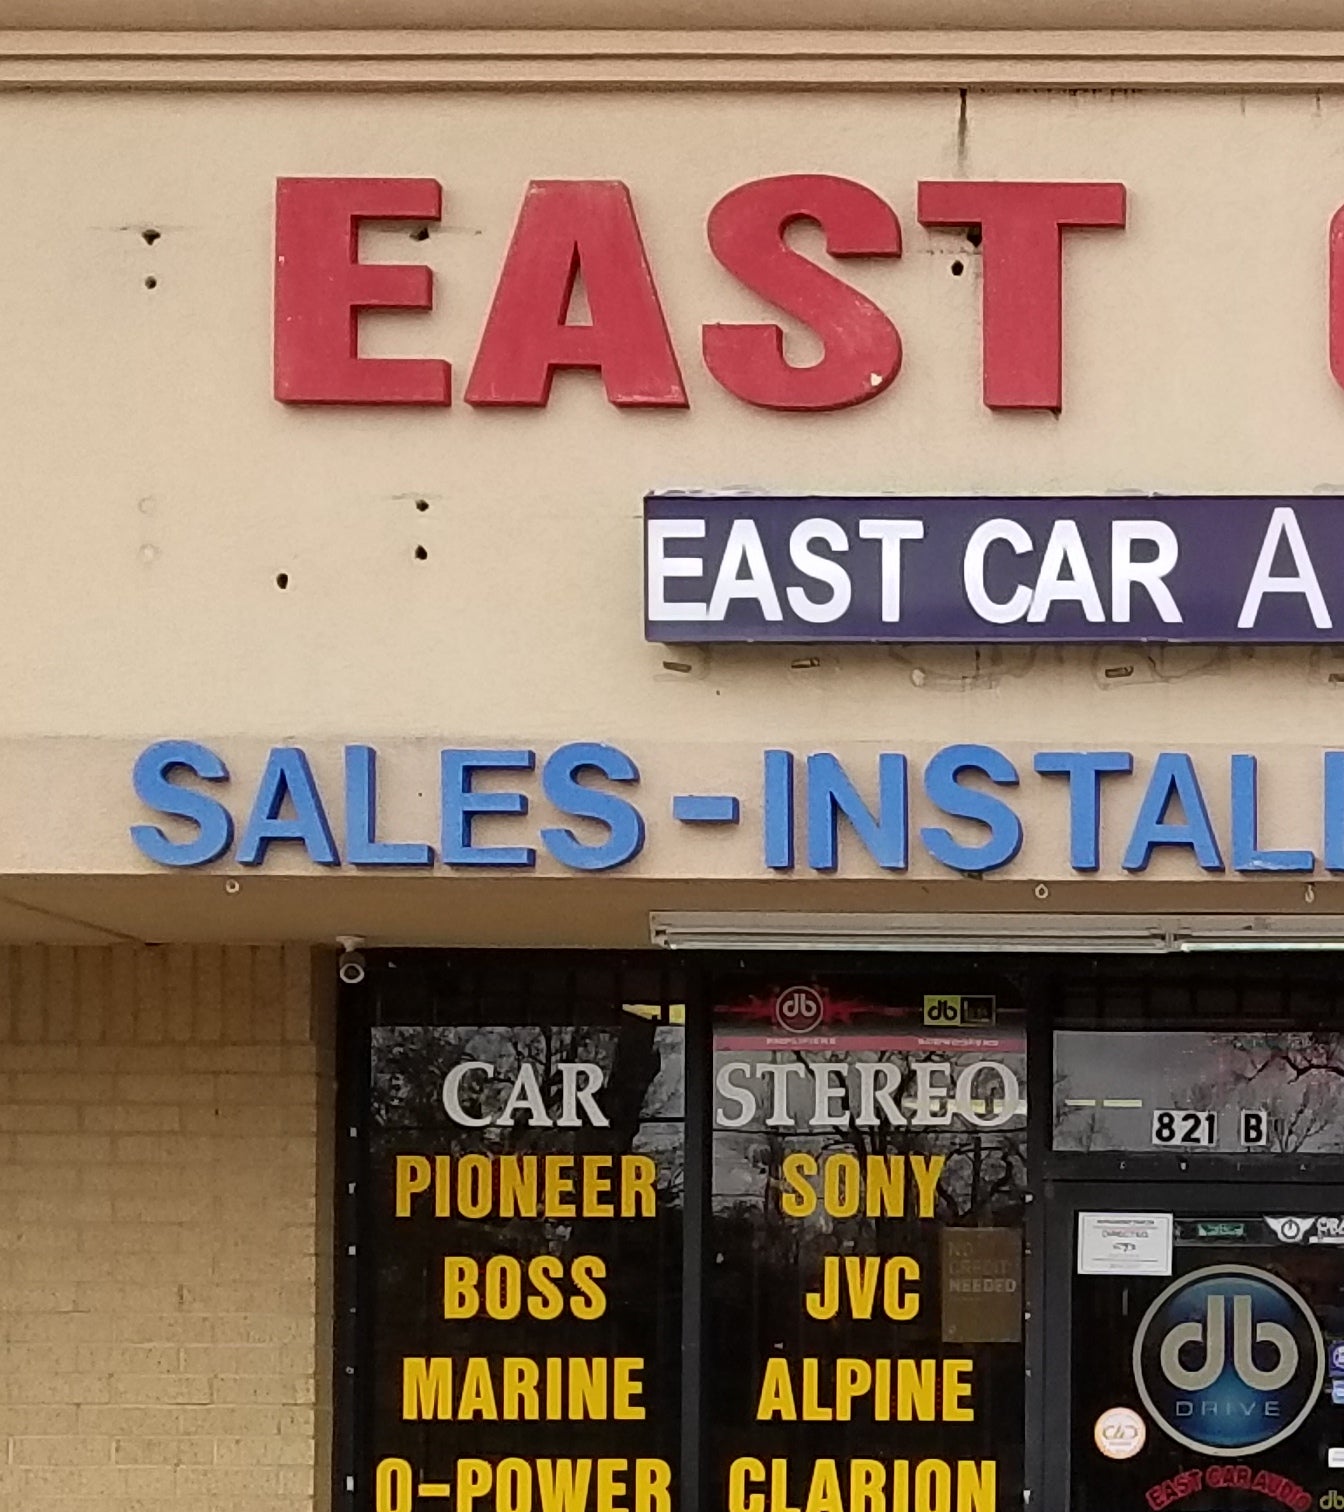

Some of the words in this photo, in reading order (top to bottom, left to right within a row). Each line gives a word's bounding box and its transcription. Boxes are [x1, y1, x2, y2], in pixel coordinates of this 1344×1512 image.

[275, 175, 1126, 412] EAST
[646, 518, 924, 624] EAST
[964, 519, 1182, 624] CAR
[442, 1062, 609, 1127] CAR
[716, 1062, 1019, 1127] STEREO
[1155, 1111, 1215, 1144] 821
[1243, 1112, 1264, 1144] B
[395, 1155, 656, 1218] PIONEER
[781, 1153, 944, 1219] SONY
[444, 1256, 607, 1320] BOSS
[806, 1256, 920, 1320] JVC
[402, 1357, 646, 1421] MARINE
[757, 1359, 974, 1421] ALPINE
[1175, 1400, 1281, 1417] DRIVE
[1145, 1469, 1202, 1511] EAST
[1206, 1465, 1252, 1488] CAR
[1252, 1470, 1312, 1512] AUDIO
